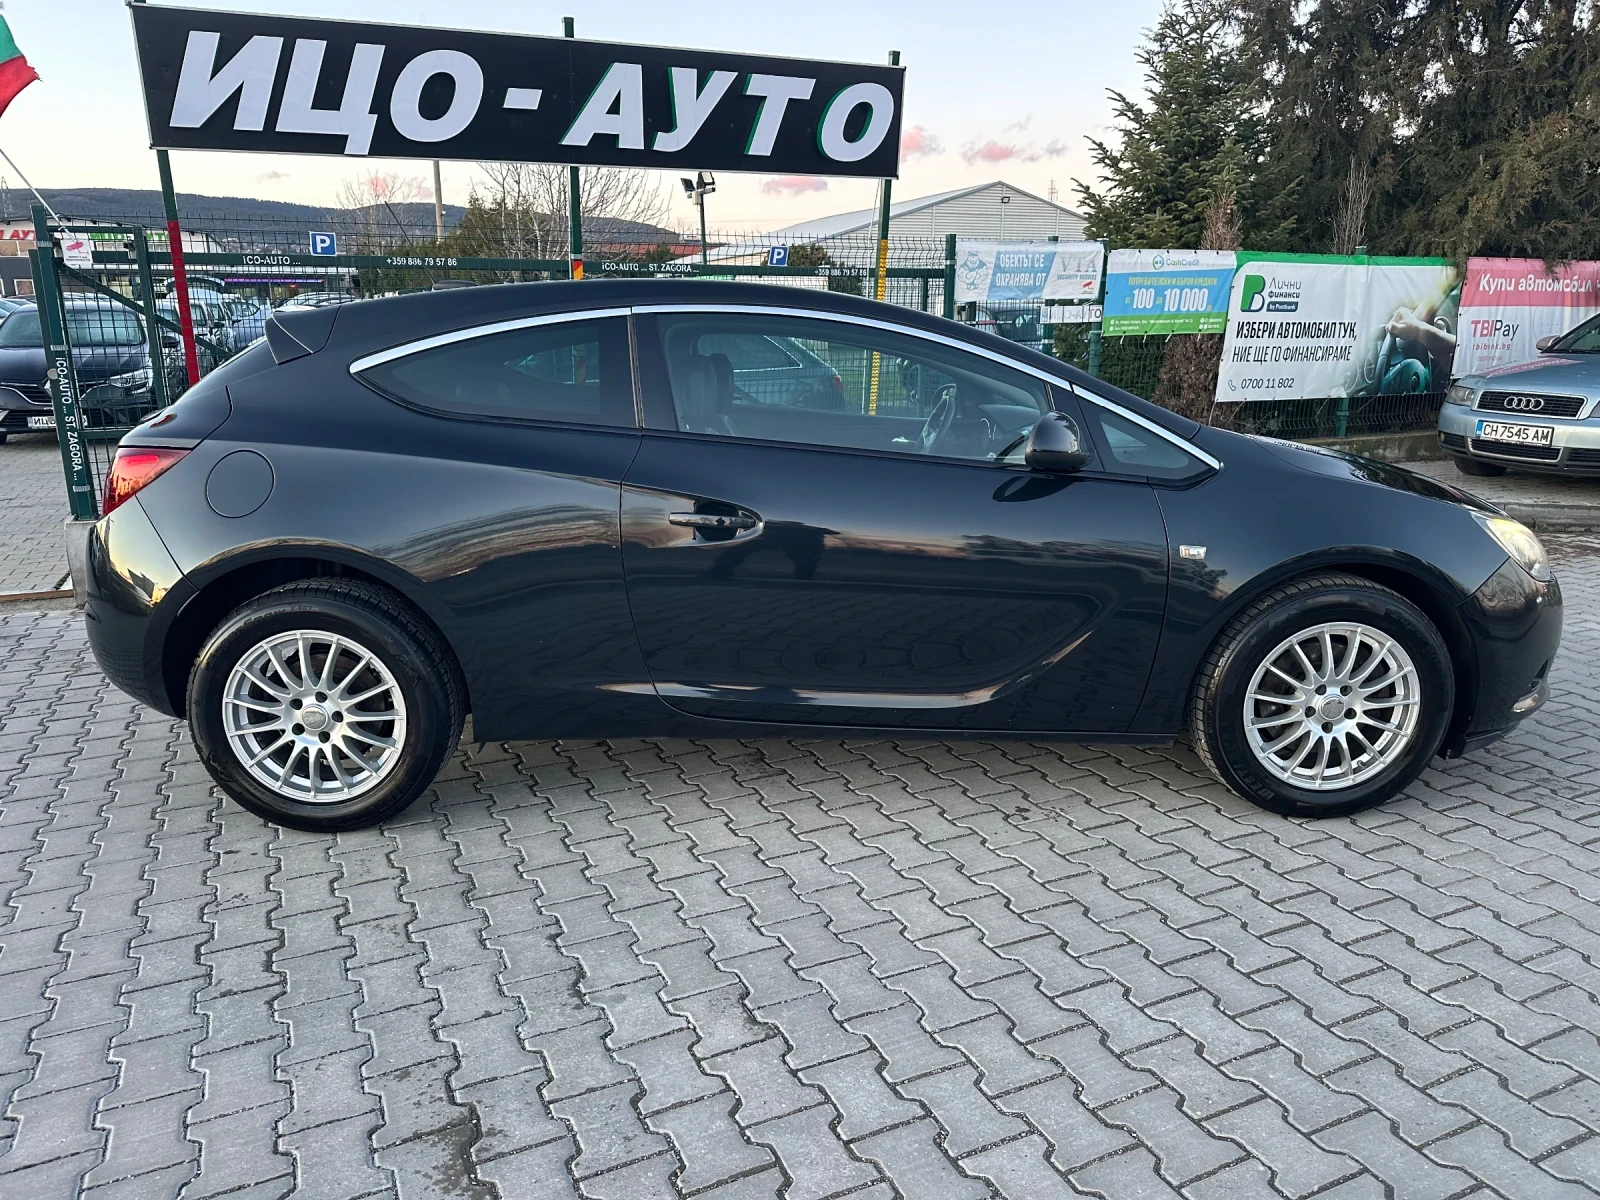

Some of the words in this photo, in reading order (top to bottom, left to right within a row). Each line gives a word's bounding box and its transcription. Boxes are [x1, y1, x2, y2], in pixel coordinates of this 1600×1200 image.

[315, 235, 331, 253] P
[386, 257, 406, 266] +359
[424, 257, 434, 266] 79
[435, 257, 445, 266] 57
[447, 257, 457, 266] 86
[772, 248, 785, 264] P
[1000, 253, 1033, 268] ОБЕКТЪТ
[1034, 254, 1045, 267] СЕ
[1166, 258, 1200, 267] CashCredit
[648, 263, 660, 271] ST.
[660, 263, 692, 272] ZAGORA
[842, 268, 850, 276] 79
[851, 268, 858, 276] 57
[1060, 256, 1097, 273] VTA
[996, 272, 1033, 287] ОХРАНЯВА
[1035, 272, 1046, 286] ОТ
[1269, 277, 1301, 290] Лични
[1479, 273, 1515, 295] Купи
[1518, 273, 1592, 293] автомобил
[1133, 288, 1155, 309] 100
[1267, 290, 1300, 299] Финанси
[1236, 321, 1276, 339] ИЗБЕРИ
[1276, 321, 1337, 339] АВТОМОБИЛ
[1338, 321, 1358, 341] ТУК,
[1232, 346, 1252, 362] НИЕ
[1253, 346, 1270, 365] ЩЕ
[1270, 346, 1282, 362] ГО
[1282, 345, 1352, 362] ФИНАНСИРАМЕ
[1241, 378, 1264, 389] 0700
[1265, 378, 1275, 389] 11
[1277, 378, 1294, 388] 802
[64, 415, 76, 429] ST.
[1483, 424, 1498, 437] CH
[1499, 425, 1529, 440] 7545
[1531, 429, 1550, 443] AM
[67, 431, 82, 471] ZAGORA
